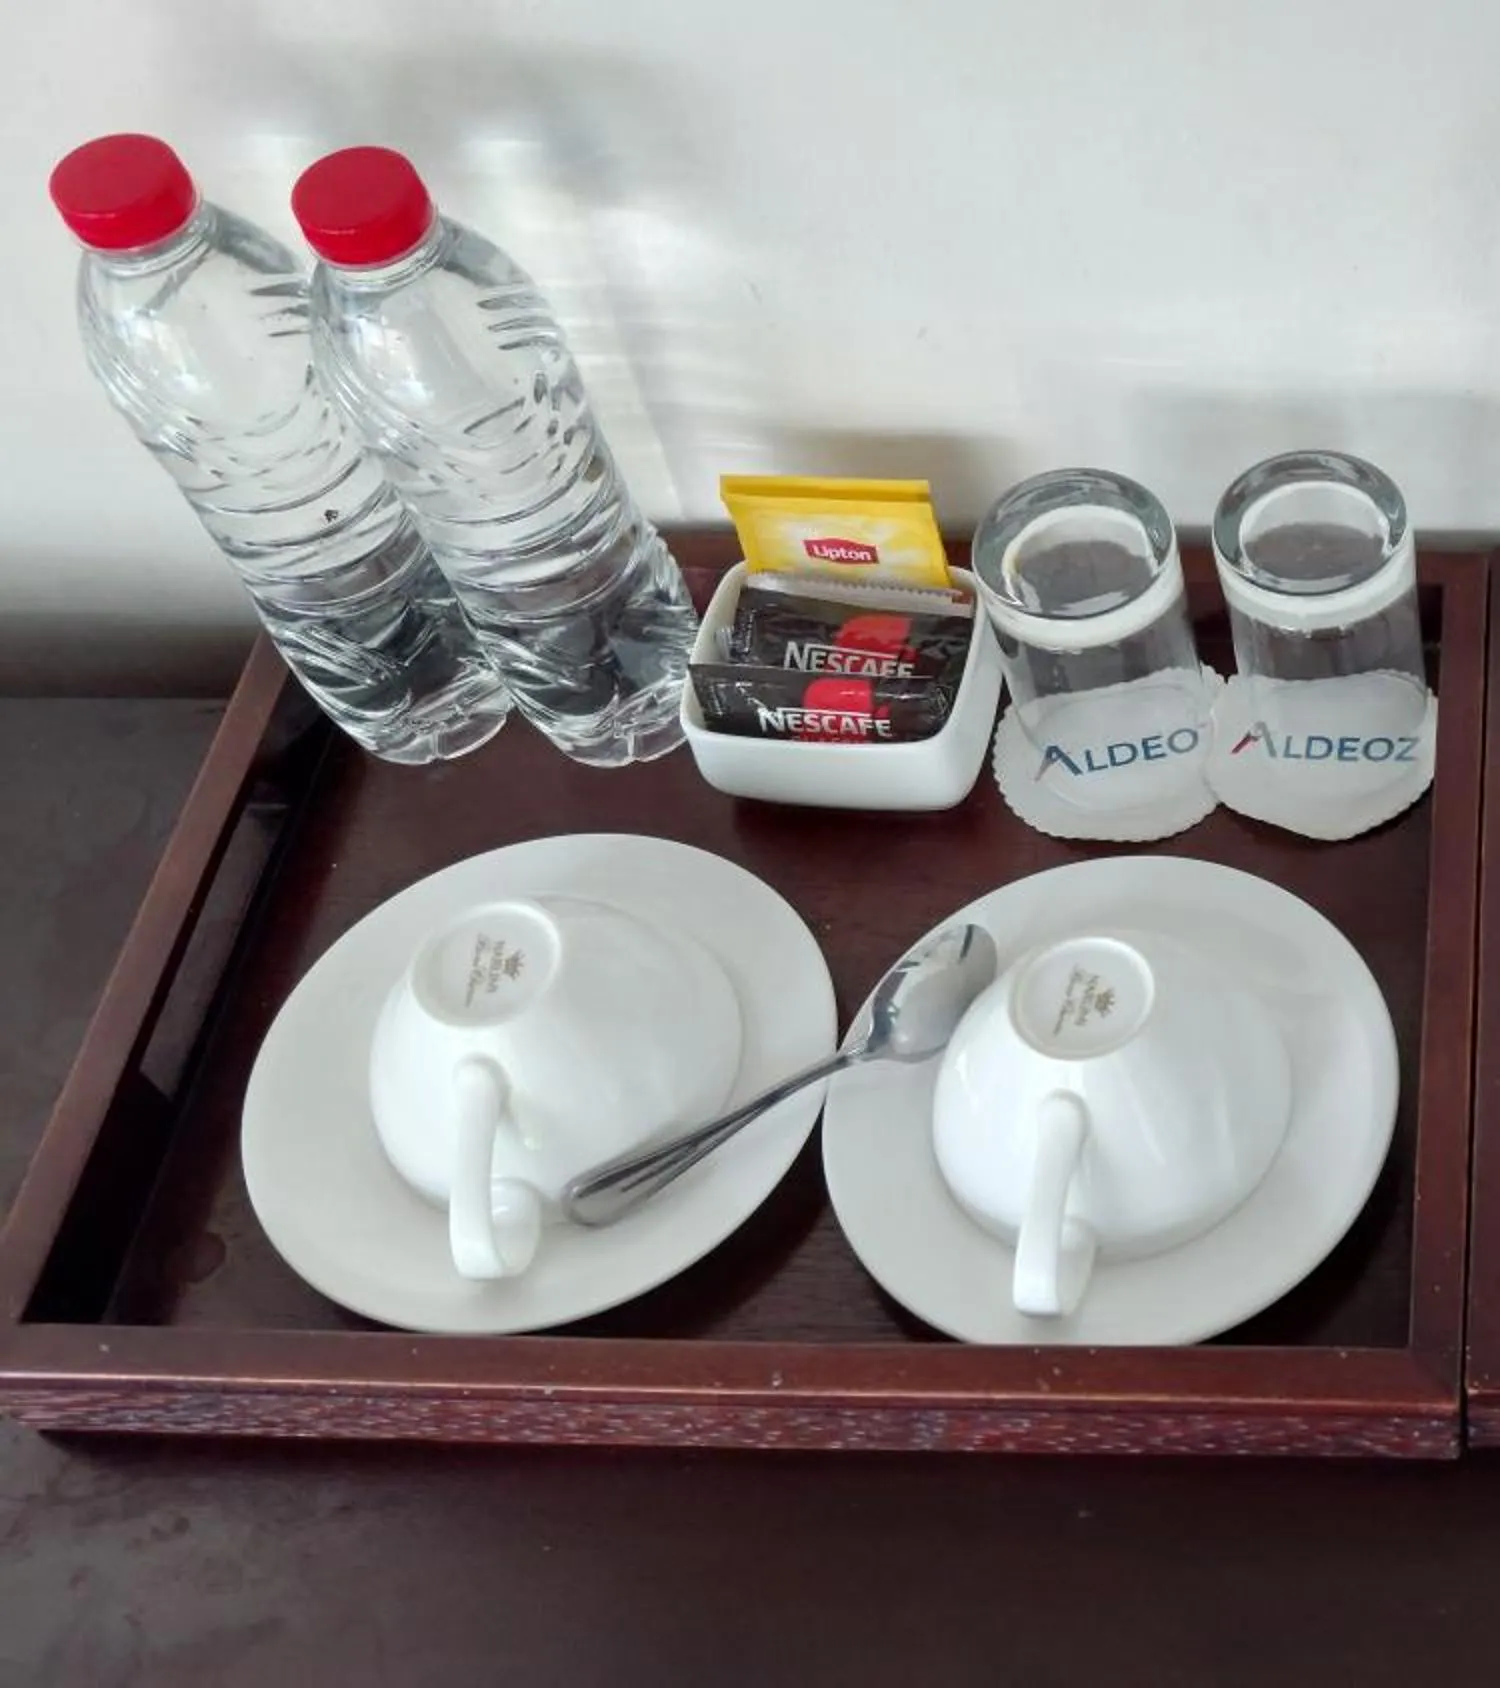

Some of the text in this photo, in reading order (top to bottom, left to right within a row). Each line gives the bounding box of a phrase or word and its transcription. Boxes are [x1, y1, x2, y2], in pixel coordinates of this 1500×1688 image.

[813, 545, 871, 561] Lipton
[1034, 723, 1207, 782] ALDEO
[1230, 721, 1421, 763] ALDEOZ
